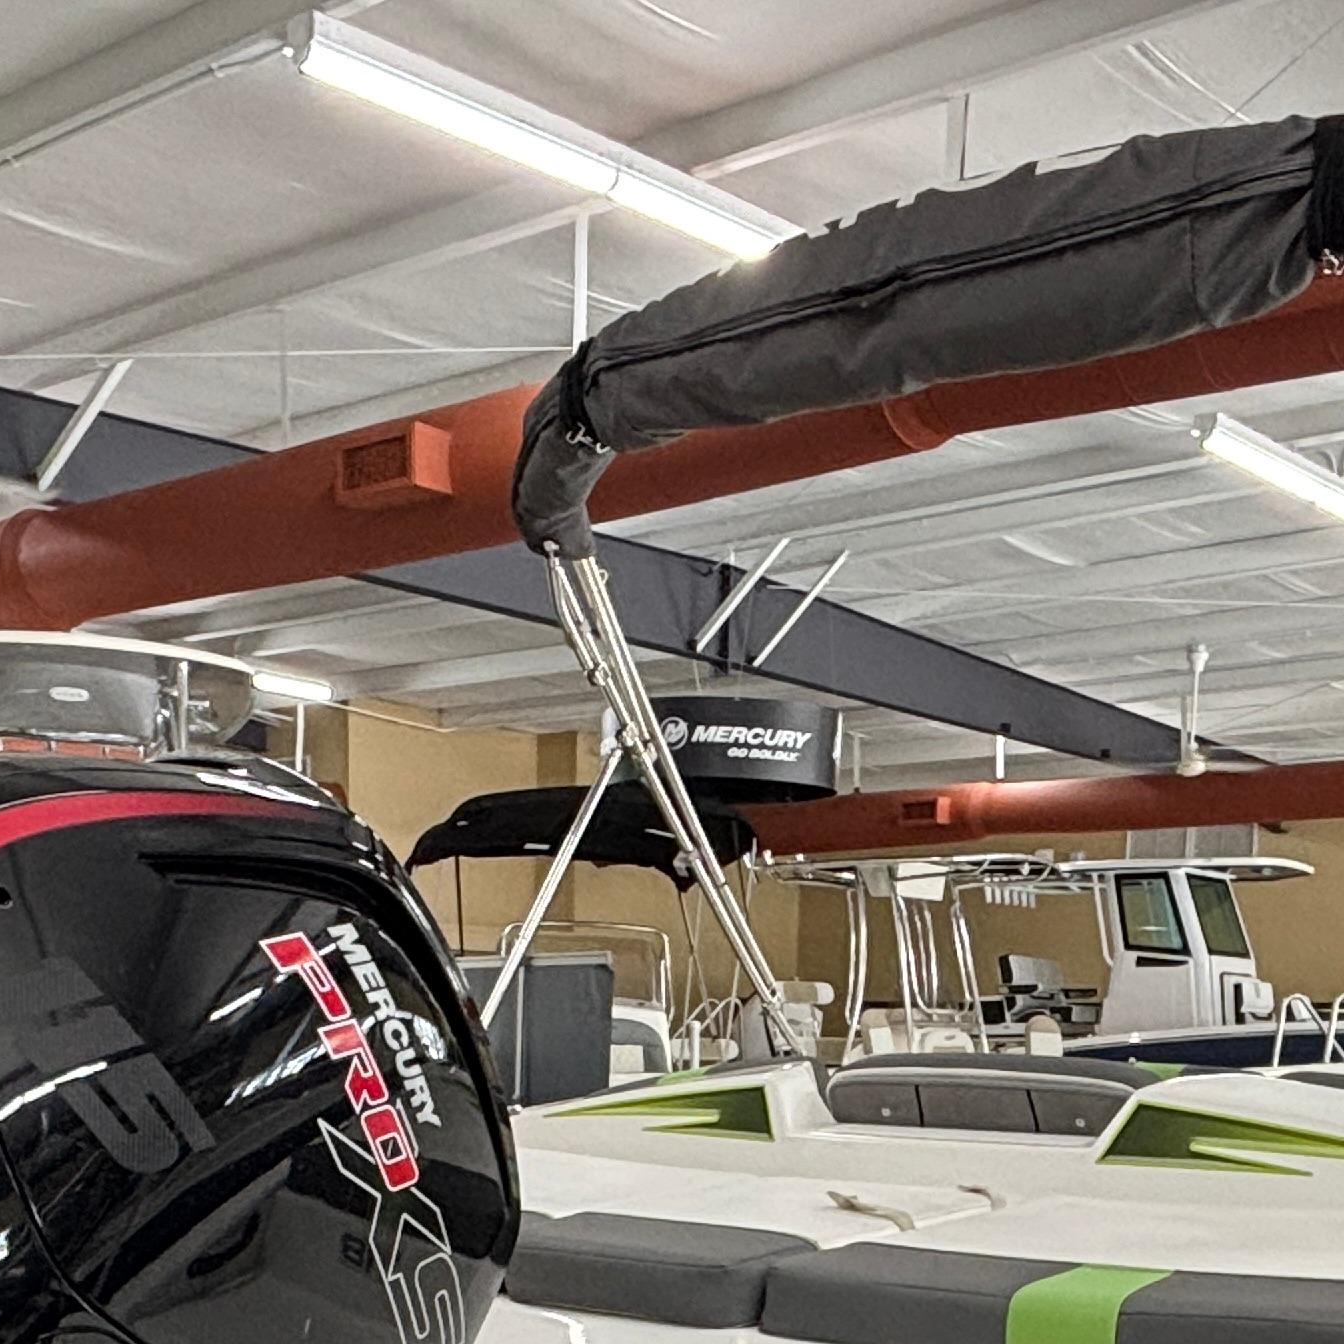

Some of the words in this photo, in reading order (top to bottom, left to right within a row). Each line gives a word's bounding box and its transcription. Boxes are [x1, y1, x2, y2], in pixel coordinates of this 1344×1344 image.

[691, 724, 813, 750] MERCURY
[258, 931, 420, 1193] PRO
[327, 922, 442, 1129] MERCURY
